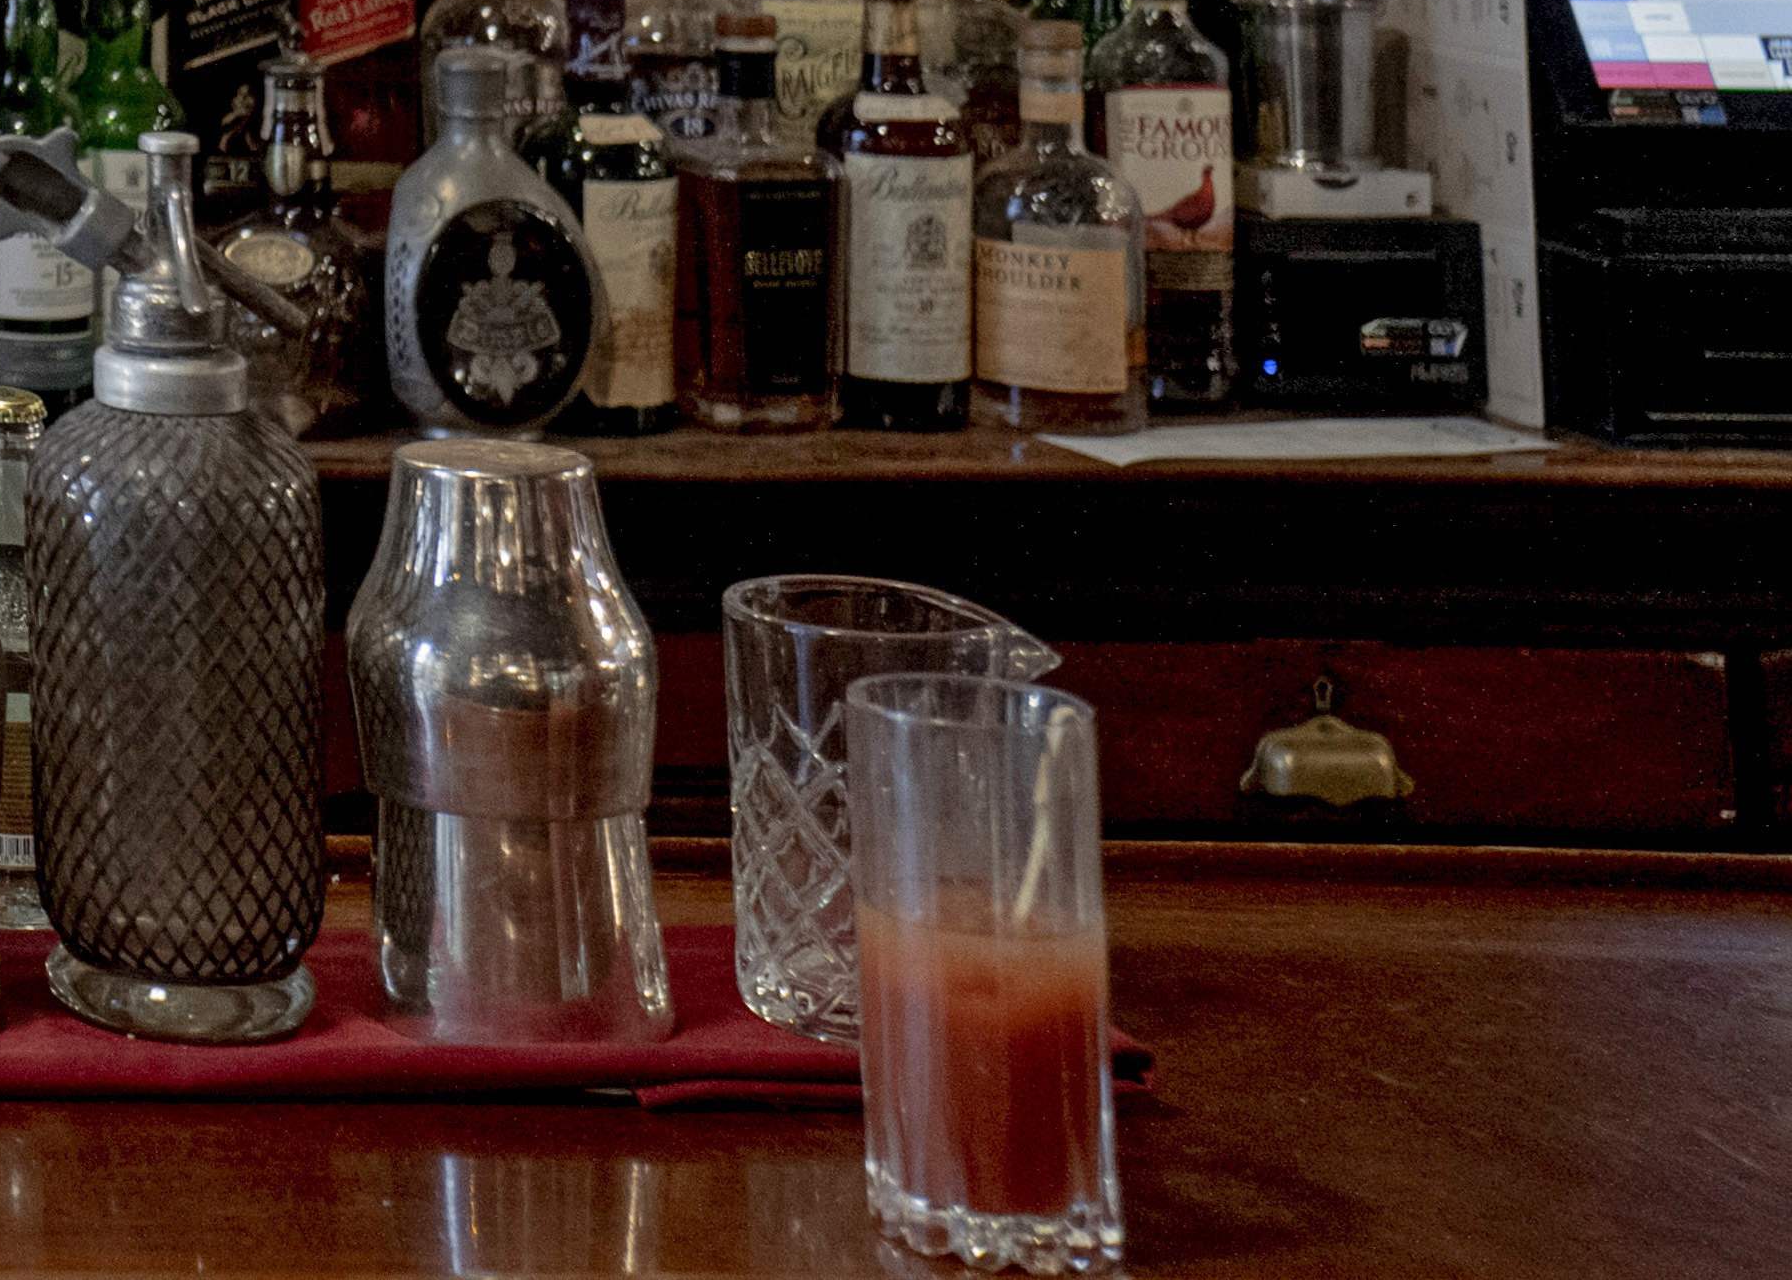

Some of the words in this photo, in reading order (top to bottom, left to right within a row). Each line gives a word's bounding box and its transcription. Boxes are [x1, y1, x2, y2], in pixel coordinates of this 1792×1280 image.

[187, 0, 239, 25] BLACK
[310, 2, 351, 33] Red
[228, 161, 249, 181] 12
